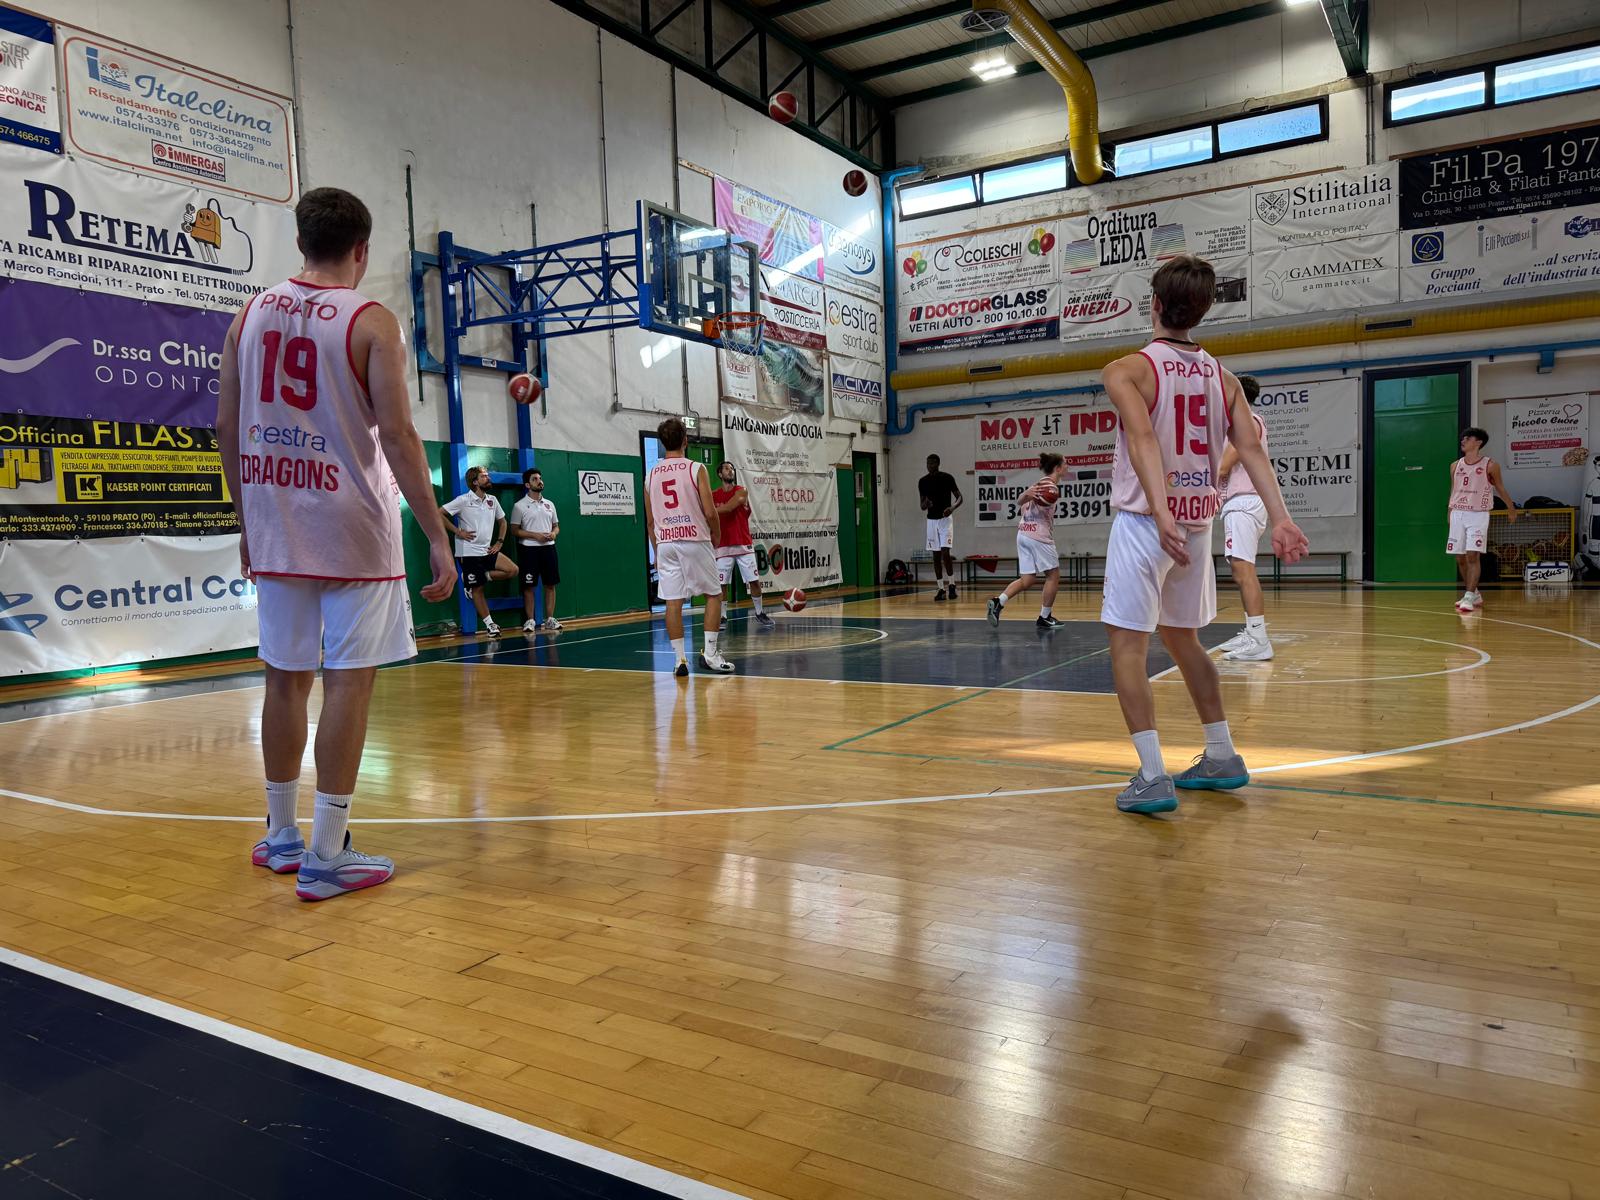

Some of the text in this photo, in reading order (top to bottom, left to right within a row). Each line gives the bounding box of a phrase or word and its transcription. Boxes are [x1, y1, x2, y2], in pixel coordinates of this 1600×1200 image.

[21, 91, 47, 104] ALTRE
[134, 74, 272, 134] Italclima
[88, 86, 272, 147] Riscaldamento Condizionamento
[78, 108, 284, 171] www.italclima.net info@italclima.net
[115, 105, 254, 152] 0574-33376 0573-364529
[1429, 150, 1524, 188] Fil.Pa
[1293, 173, 1392, 206] Stilitalia
[1421, 184, 1482, 205] Ciniglia
[1488, 180, 1502, 194] &
[1509, 173, 1551, 192] Filati
[1293, 194, 1392, 219] International
[1088, 211, 1157, 240] Orditura
[1277, 229, 1330, 243] MONTEMURLO
[1348, 223, 1369, 233] ITALY
[963, 241, 1022, 264] COLESCHI
[1099, 231, 1147, 267] LEDA
[18, 243, 83, 266] RICAMBI
[88, 255, 178, 281] RIPARAZIONI
[1289, 256, 1384, 279] GAMMATEX
[1430, 265, 1475, 281] Gruppo
[4, 259, 43, 274] Marco
[135, 282, 164, 295] Prato
[174, 288, 192, 299] Tel.
[194, 291, 216, 304] 0574
[1302, 276, 1371, 292] gammatex.it
[1425, 278, 1481, 295] Poccianti
[1503, 265, 1588, 286] dell'industria
[259, 293, 338, 321] PRATO
[924, 289, 1048, 320] DOCTORGLASS
[1063, 298, 1119, 319] VENEZIA
[1067, 291, 1113, 305] CAR SERVICE
[840, 304, 878, 336] estra
[909, 306, 1047, 333] VETRI AUTO 800 10.10.10
[93, 339, 151, 362] Dr.ssa
[842, 333, 863, 349] sport
[260, 330, 318, 411] 19
[832, 392, 882, 408] IMPIANTI
[1257, 406, 1309, 416] Costruzioni
[1528, 408, 1561, 416] Pizzeria
[1550, 416, 1579, 424] Cuore
[0, 425, 84, 446] Officina
[980, 410, 1117, 441] MOV IND
[263, 425, 327, 453] estra
[980, 439, 1069, 452] CARRELLI ELEVATORI
[60, 452, 84, 461] VENDITA
[240, 454, 340, 492] DRAGONS
[654, 462, 687, 475] PRATO
[106, 482, 212, 492] KAESER POINT CERTIFICATI
[588, 475, 627, 493] PENTA
[1290, 474, 1353, 487] Software
[1463, 476, 1469, 486] 8
[661, 478, 679, 509] 5
[770, 487, 815, 504] RECORD
[978, 485, 1030, 501] RANIER
[9, 514, 73, 524] Monterotondo,
[87, 514, 111, 522] 59100
[112, 513, 139, 521] PRATO
[141, 513, 156, 522] (PO)
[165, 512, 191, 520] E-mail:
[21, 524, 77, 533] 333.4274909
[83, 523, 125, 531] Francesco:
[126, 521, 168, 530] 336.670185
[175, 520, 202, 528] Simone
[1529, 568, 1563, 582] Sixtus
[54, 576, 192, 611] Central
[61, 614, 122, 627] Connettiamo
[124, 612, 130, 621] il
[131, 610, 163, 620] mondo
[164, 609, 181, 617] una
[182, 603, 228, 617] spedizione
